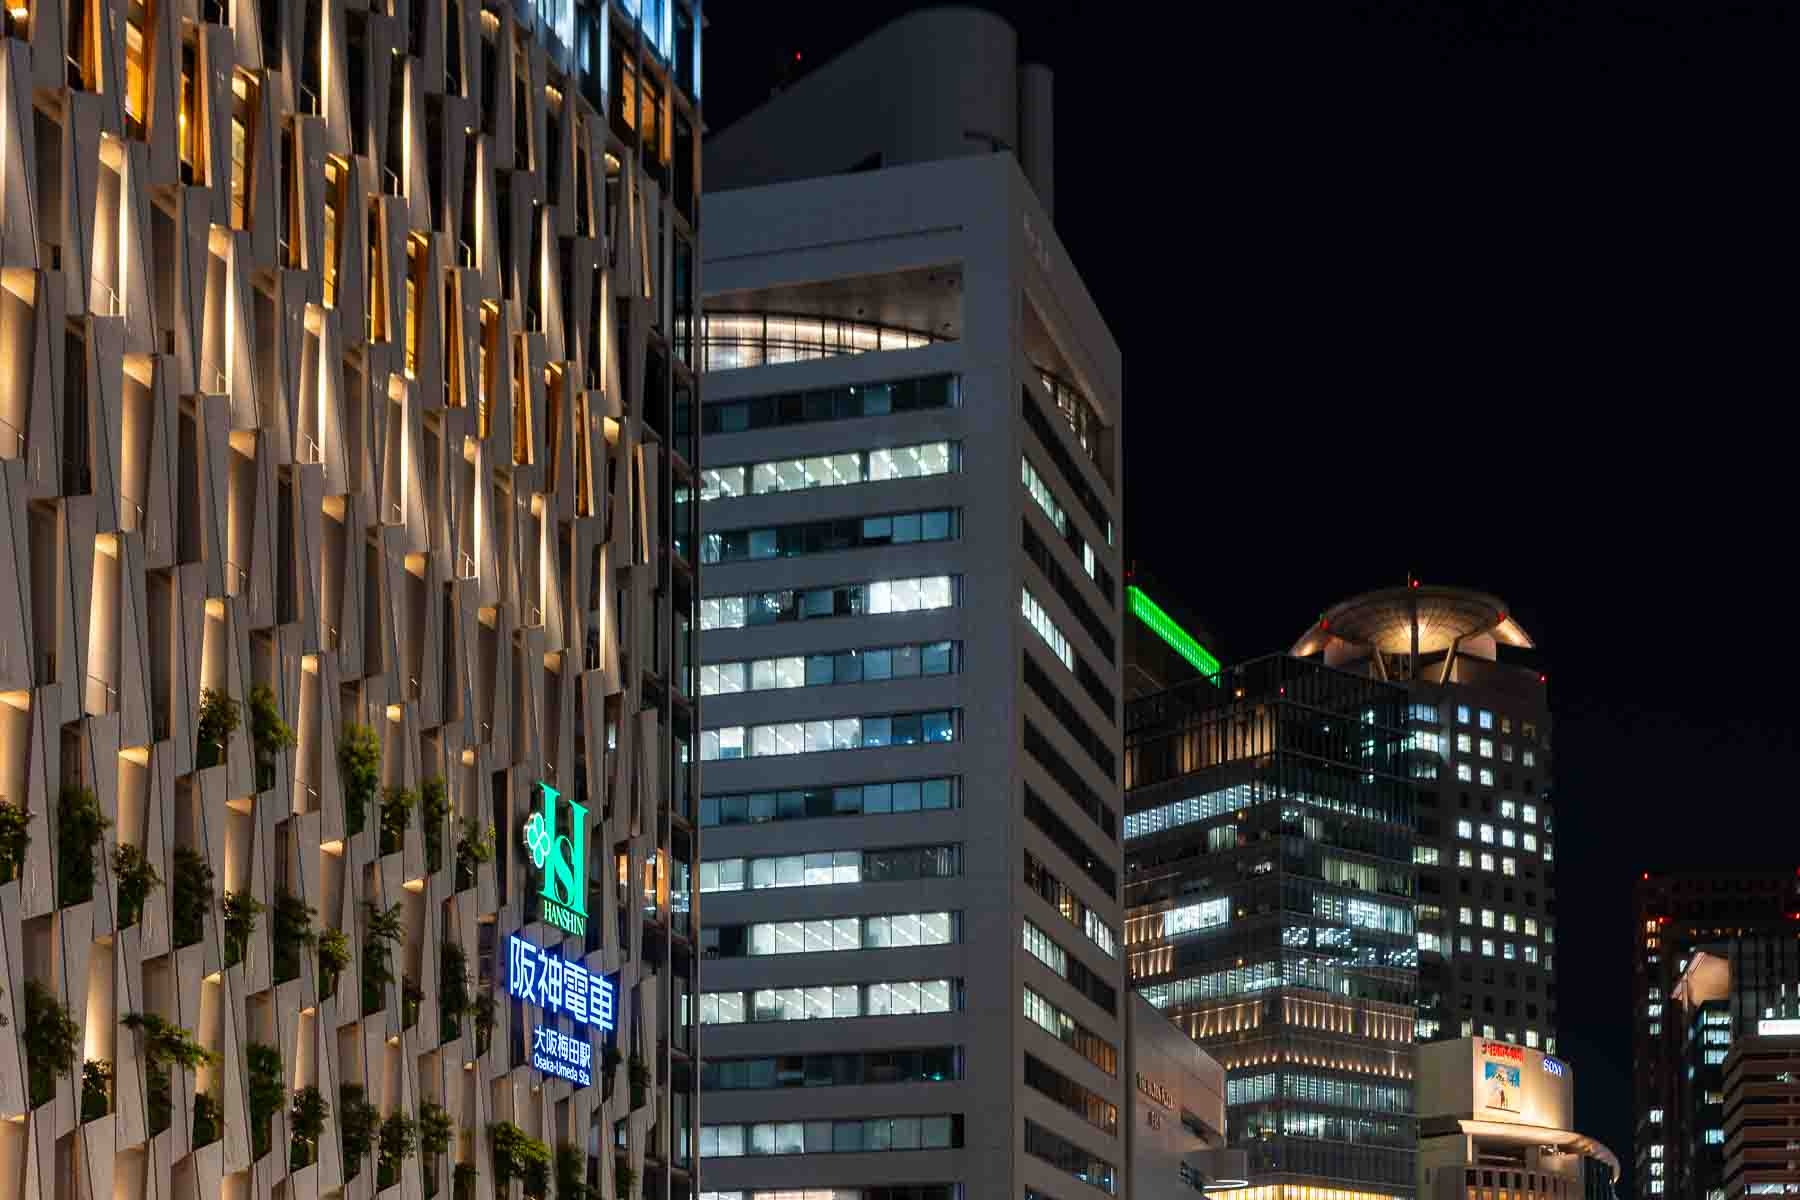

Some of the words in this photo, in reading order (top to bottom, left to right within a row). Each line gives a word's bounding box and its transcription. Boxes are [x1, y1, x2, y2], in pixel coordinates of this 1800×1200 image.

[544, 900, 584, 936] HANSHIN
[510, 935, 613, 1031] 阪神電車
[534, 1025, 591, 1069] 大阪梅田駅
[534, 1053, 578, 1081] Osaka-Umeda
[1543, 1058, 1563, 1078] SONY
